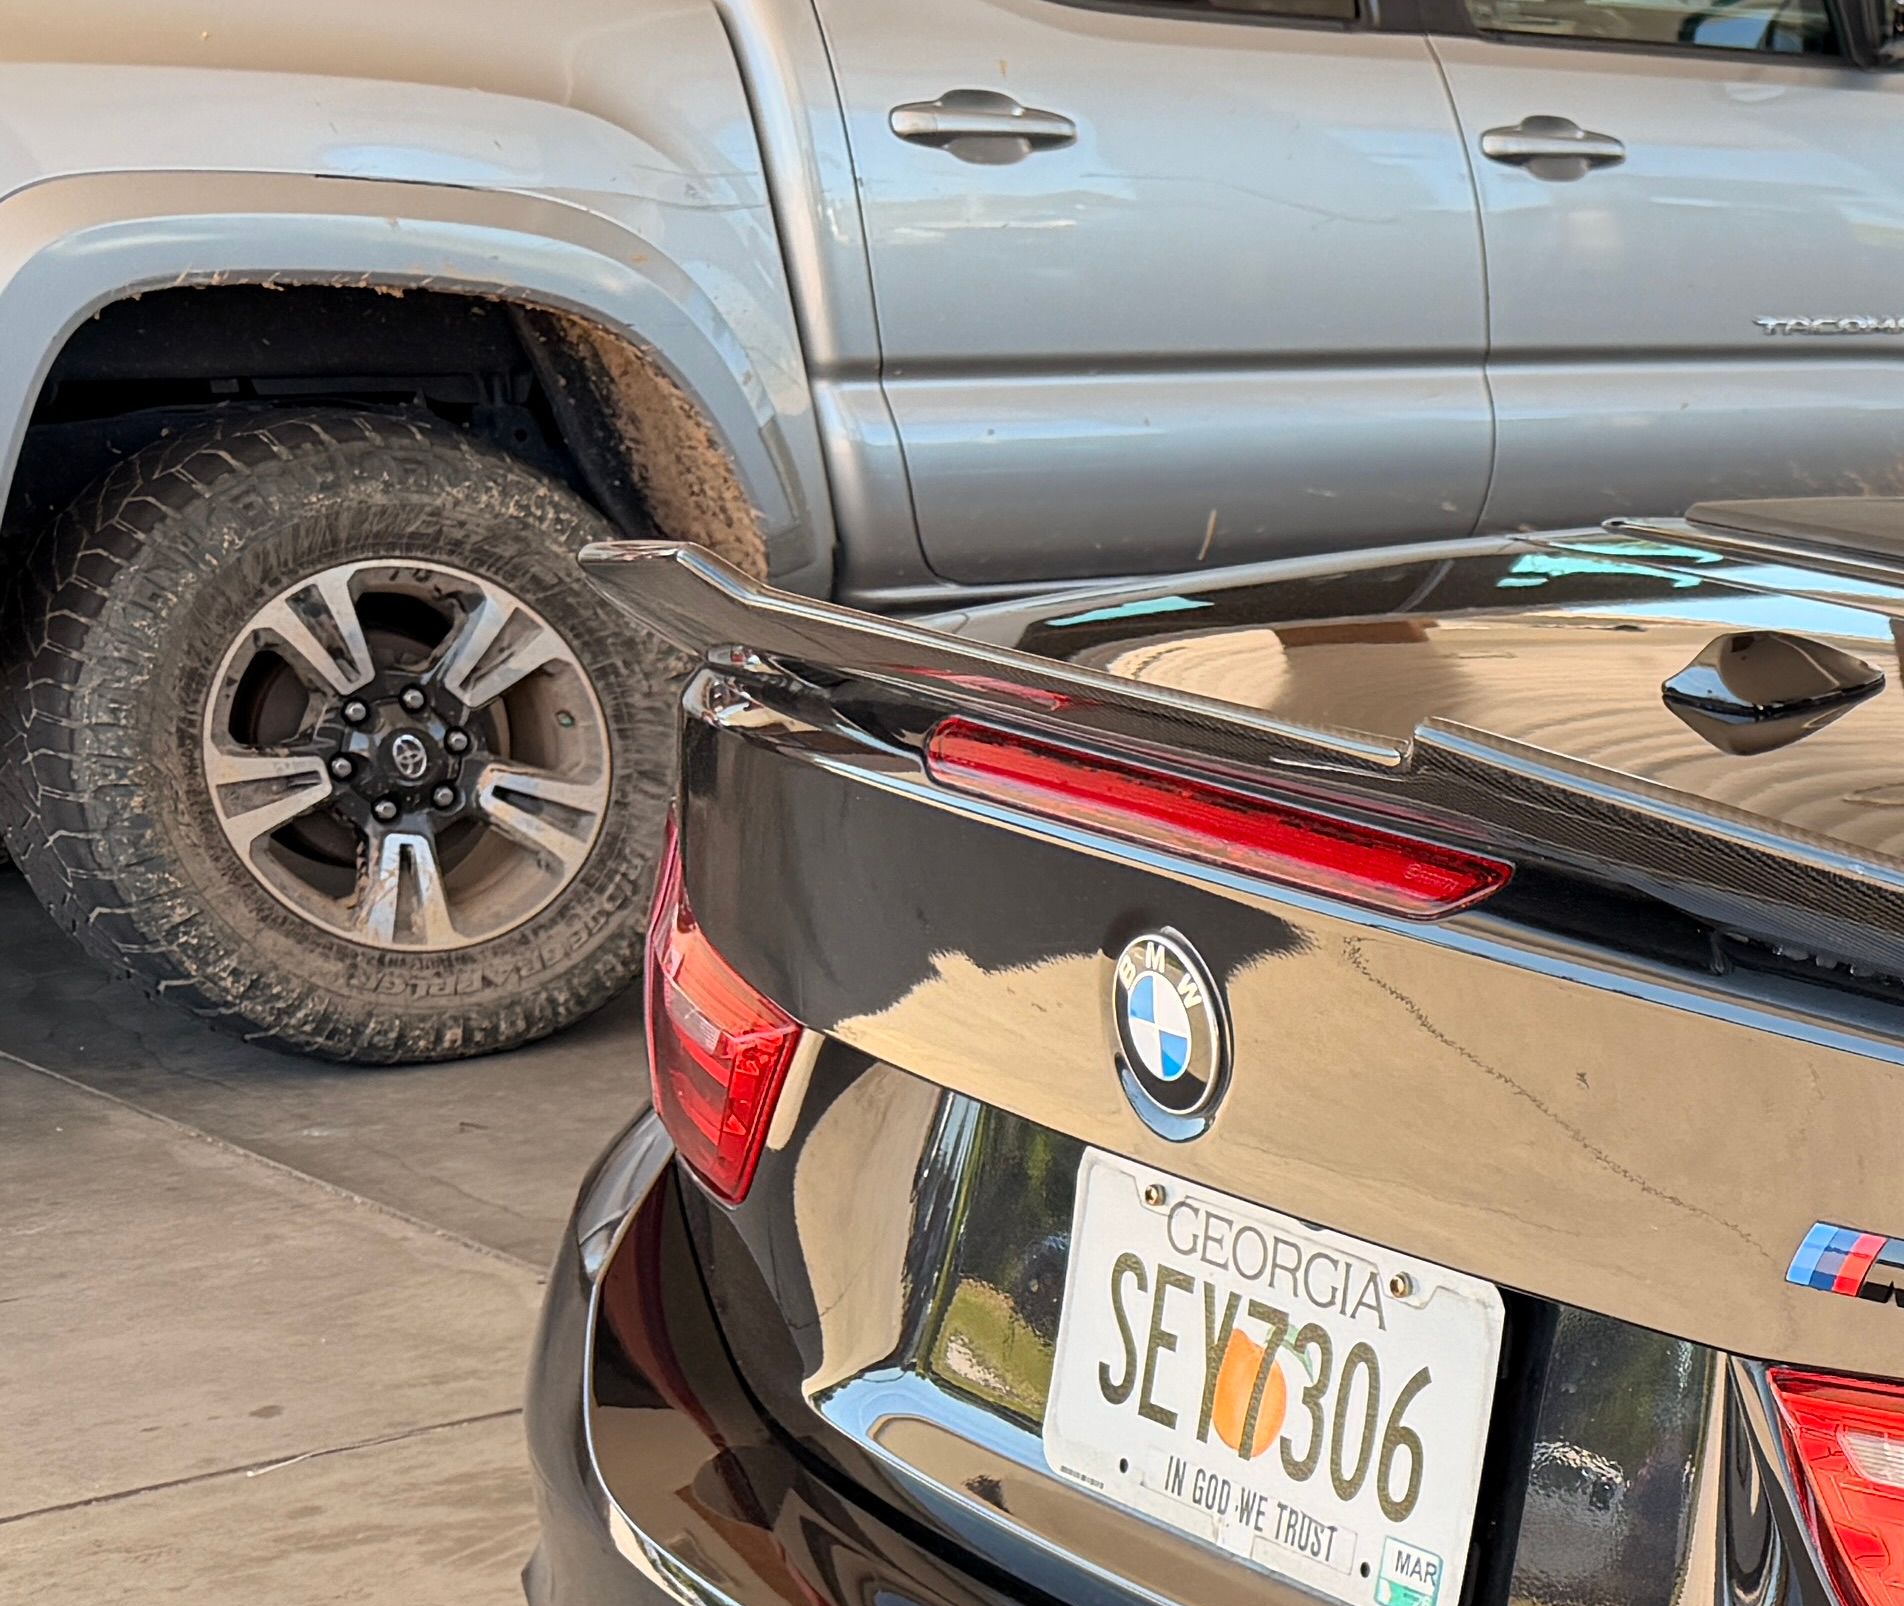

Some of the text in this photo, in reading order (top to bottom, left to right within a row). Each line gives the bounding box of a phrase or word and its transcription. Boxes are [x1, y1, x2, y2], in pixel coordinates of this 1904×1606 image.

[1118, 942, 1202, 1009] BMW
[1167, 1195, 1387, 1331] GEORGIA
[1098, 1252, 1432, 1523] SEY7306
[1164, 1455, 1338, 1562] IN GOD WE TRUST
[1394, 1550, 1438, 1588] MAR
